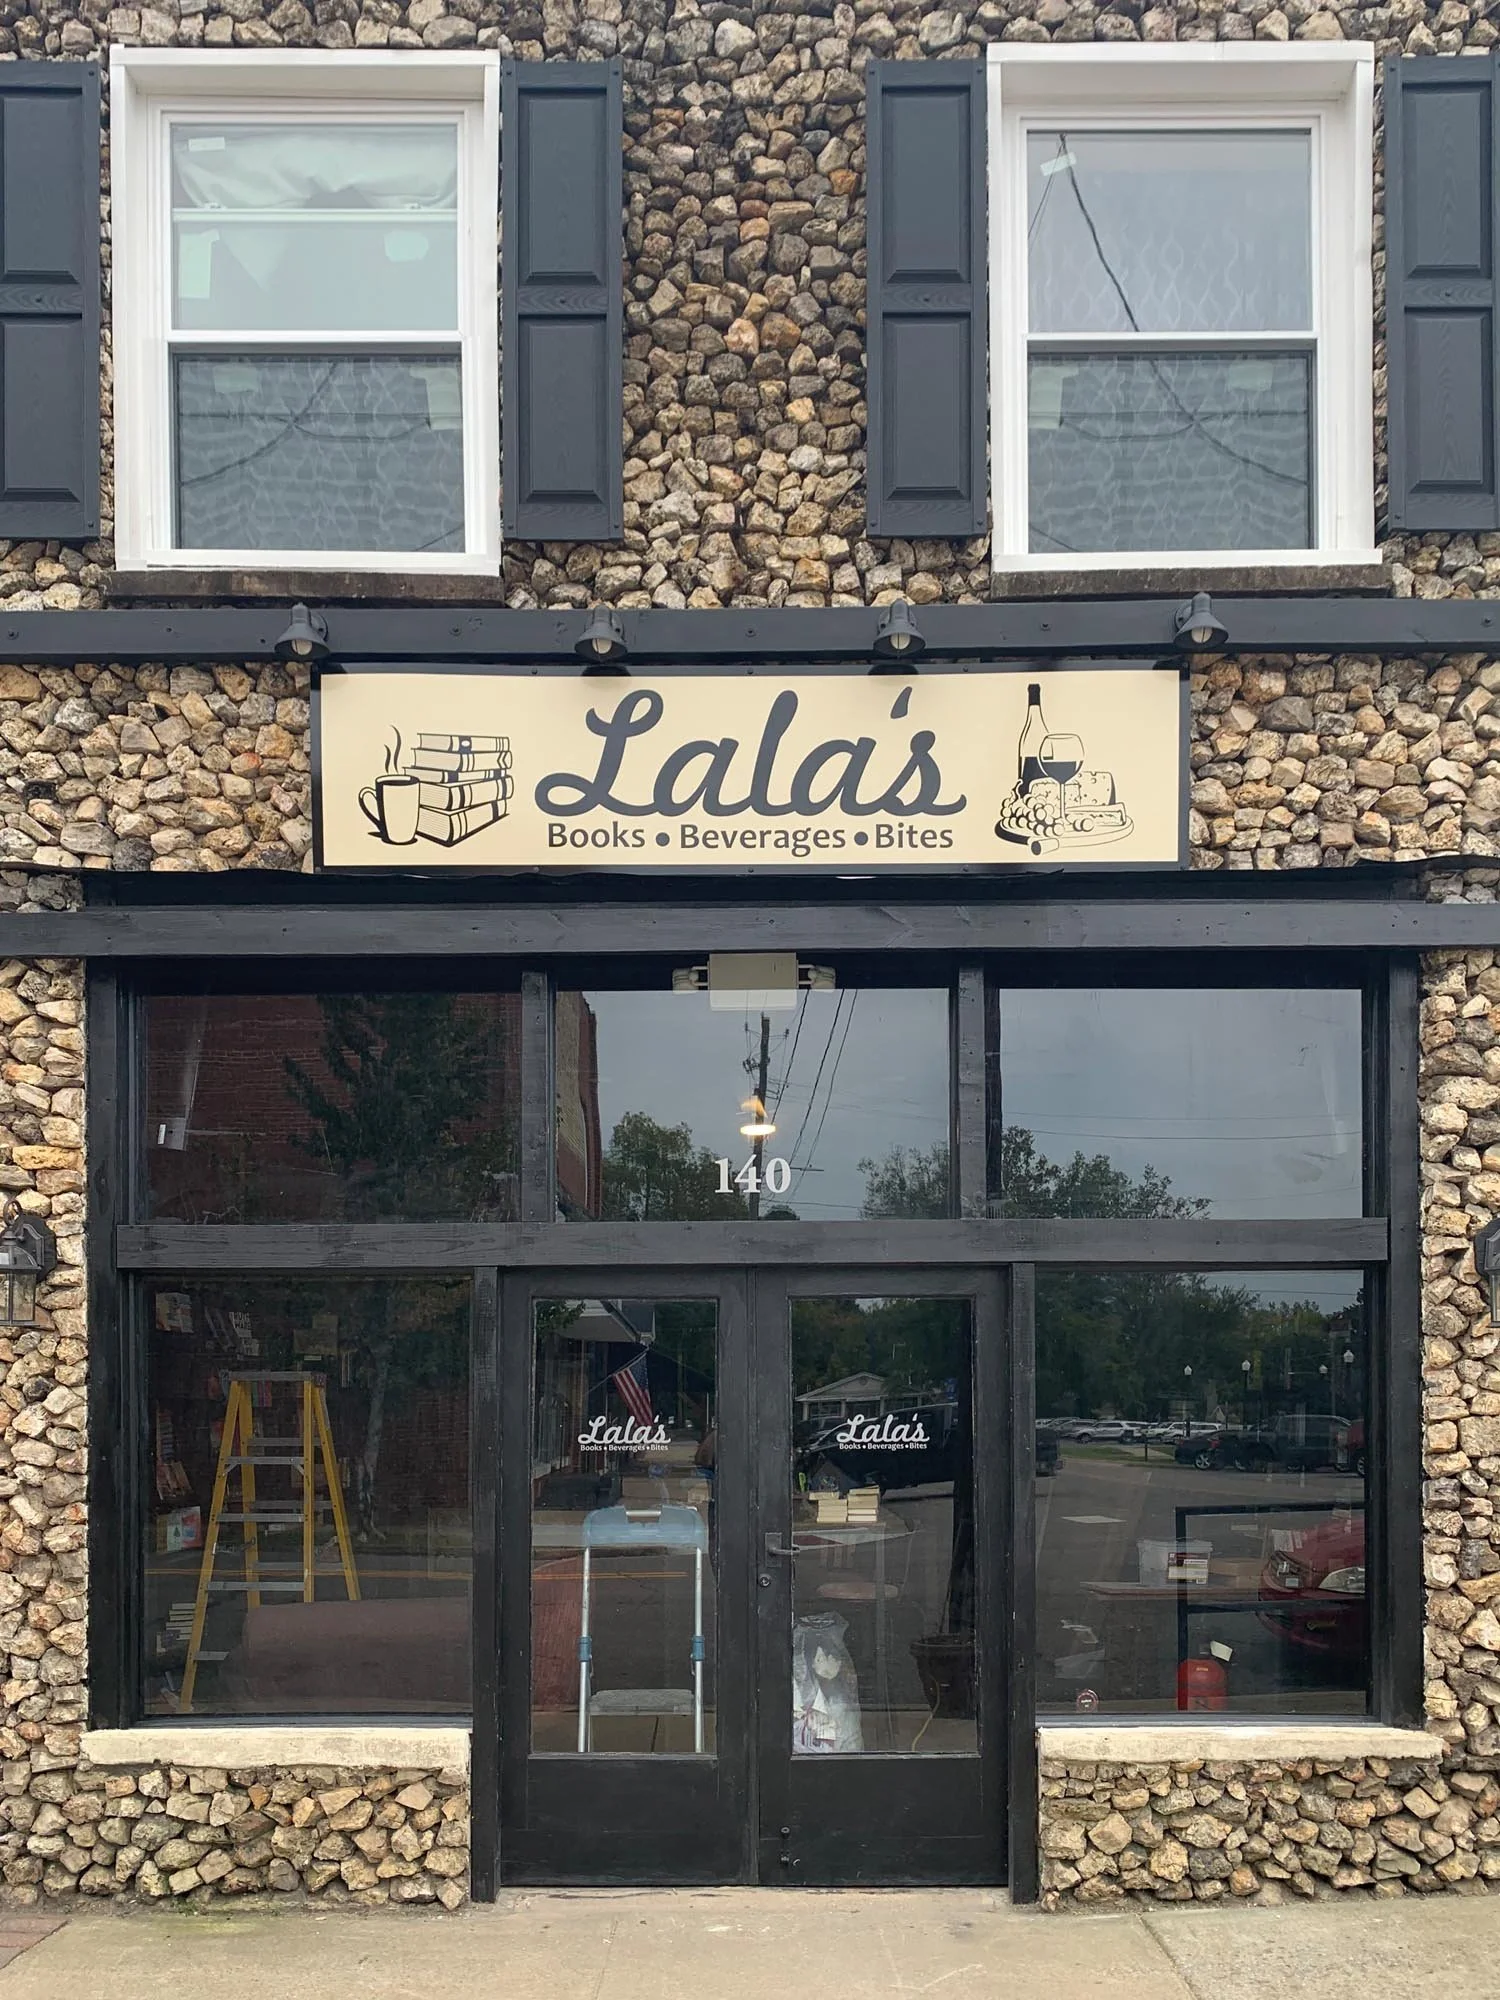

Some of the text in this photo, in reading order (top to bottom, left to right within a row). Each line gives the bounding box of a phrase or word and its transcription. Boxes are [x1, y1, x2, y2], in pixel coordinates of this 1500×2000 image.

[534, 687, 967, 817] Lala's
[548, 821, 954, 858] Books Beverages Bites
[714, 1154, 792, 1194] 140
[577, 1414, 672, 1444] Lala's
[836, 1412, 931, 1443] Lala's
[608, 1444, 646, 1453] Beverages
[650, 1443, 669, 1451] Bites
[839, 1442, 928, 1452] Books Beverages Bites
